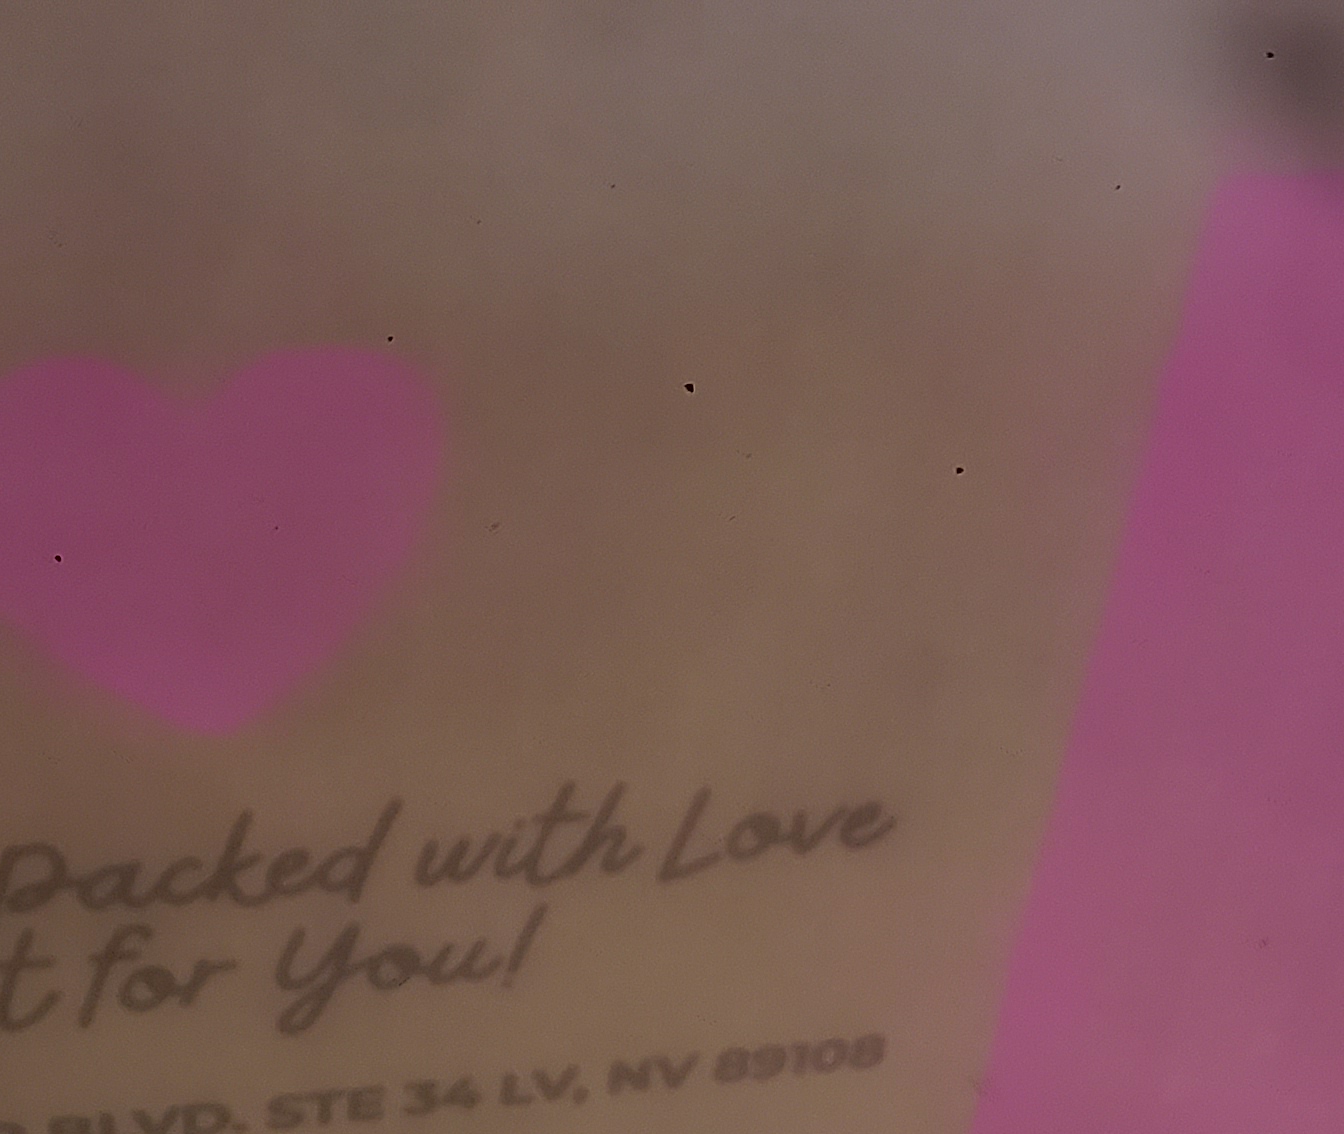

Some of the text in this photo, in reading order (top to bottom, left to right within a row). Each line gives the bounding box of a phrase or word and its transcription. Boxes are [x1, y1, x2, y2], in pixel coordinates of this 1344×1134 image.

[415, 780, 644, 888] with
[658, 786, 896, 883] Love
[77, 922, 238, 1030] for
[274, 903, 549, 1035] You!
[267, 1085, 385, 1132] STE
[403, 1078, 481, 1118] 34
[607, 1052, 699, 1097] NV
[713, 1033, 887, 1084] 89108
